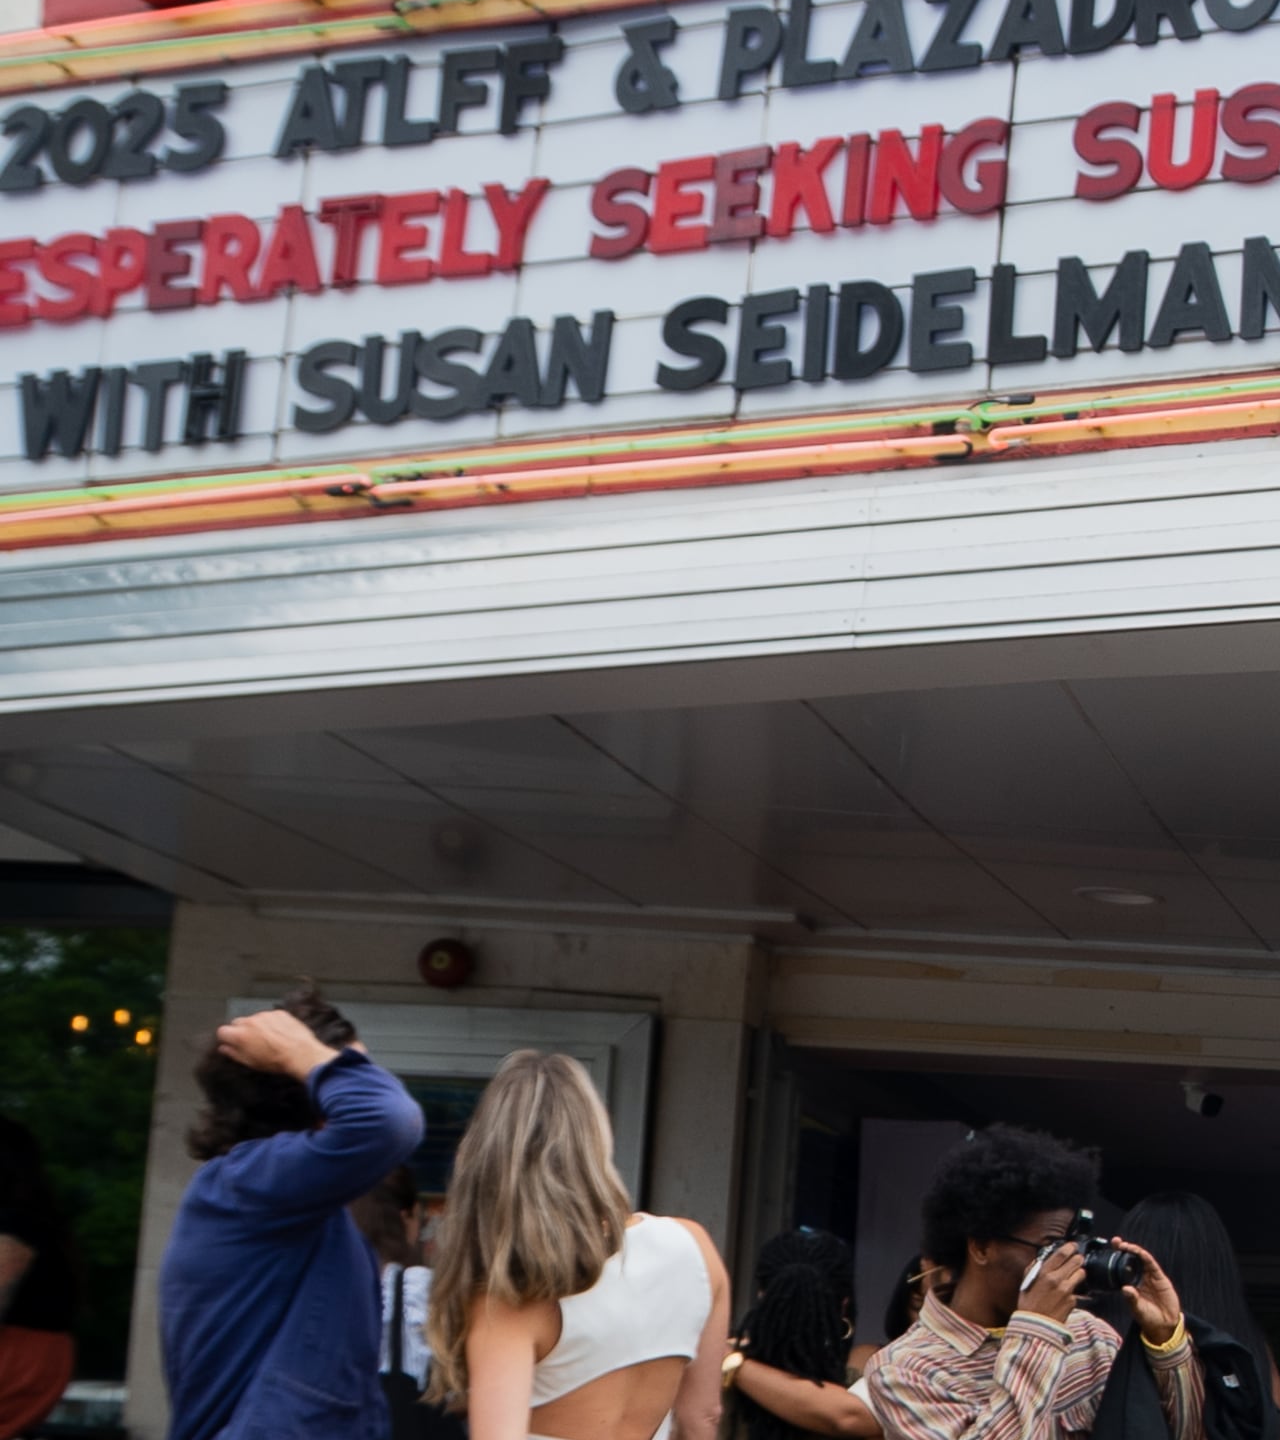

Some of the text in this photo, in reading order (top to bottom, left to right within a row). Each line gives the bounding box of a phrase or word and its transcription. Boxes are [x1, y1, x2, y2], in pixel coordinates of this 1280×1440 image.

[0, 81, 227, 191] 2025
[275, 34, 563, 158] ATLFF
[614, 16, 680, 116] &
[590, 117, 1011, 260] SEEKING
[20, 348, 247, 461] WITH
[293, 308, 615, 435] SUSAN
